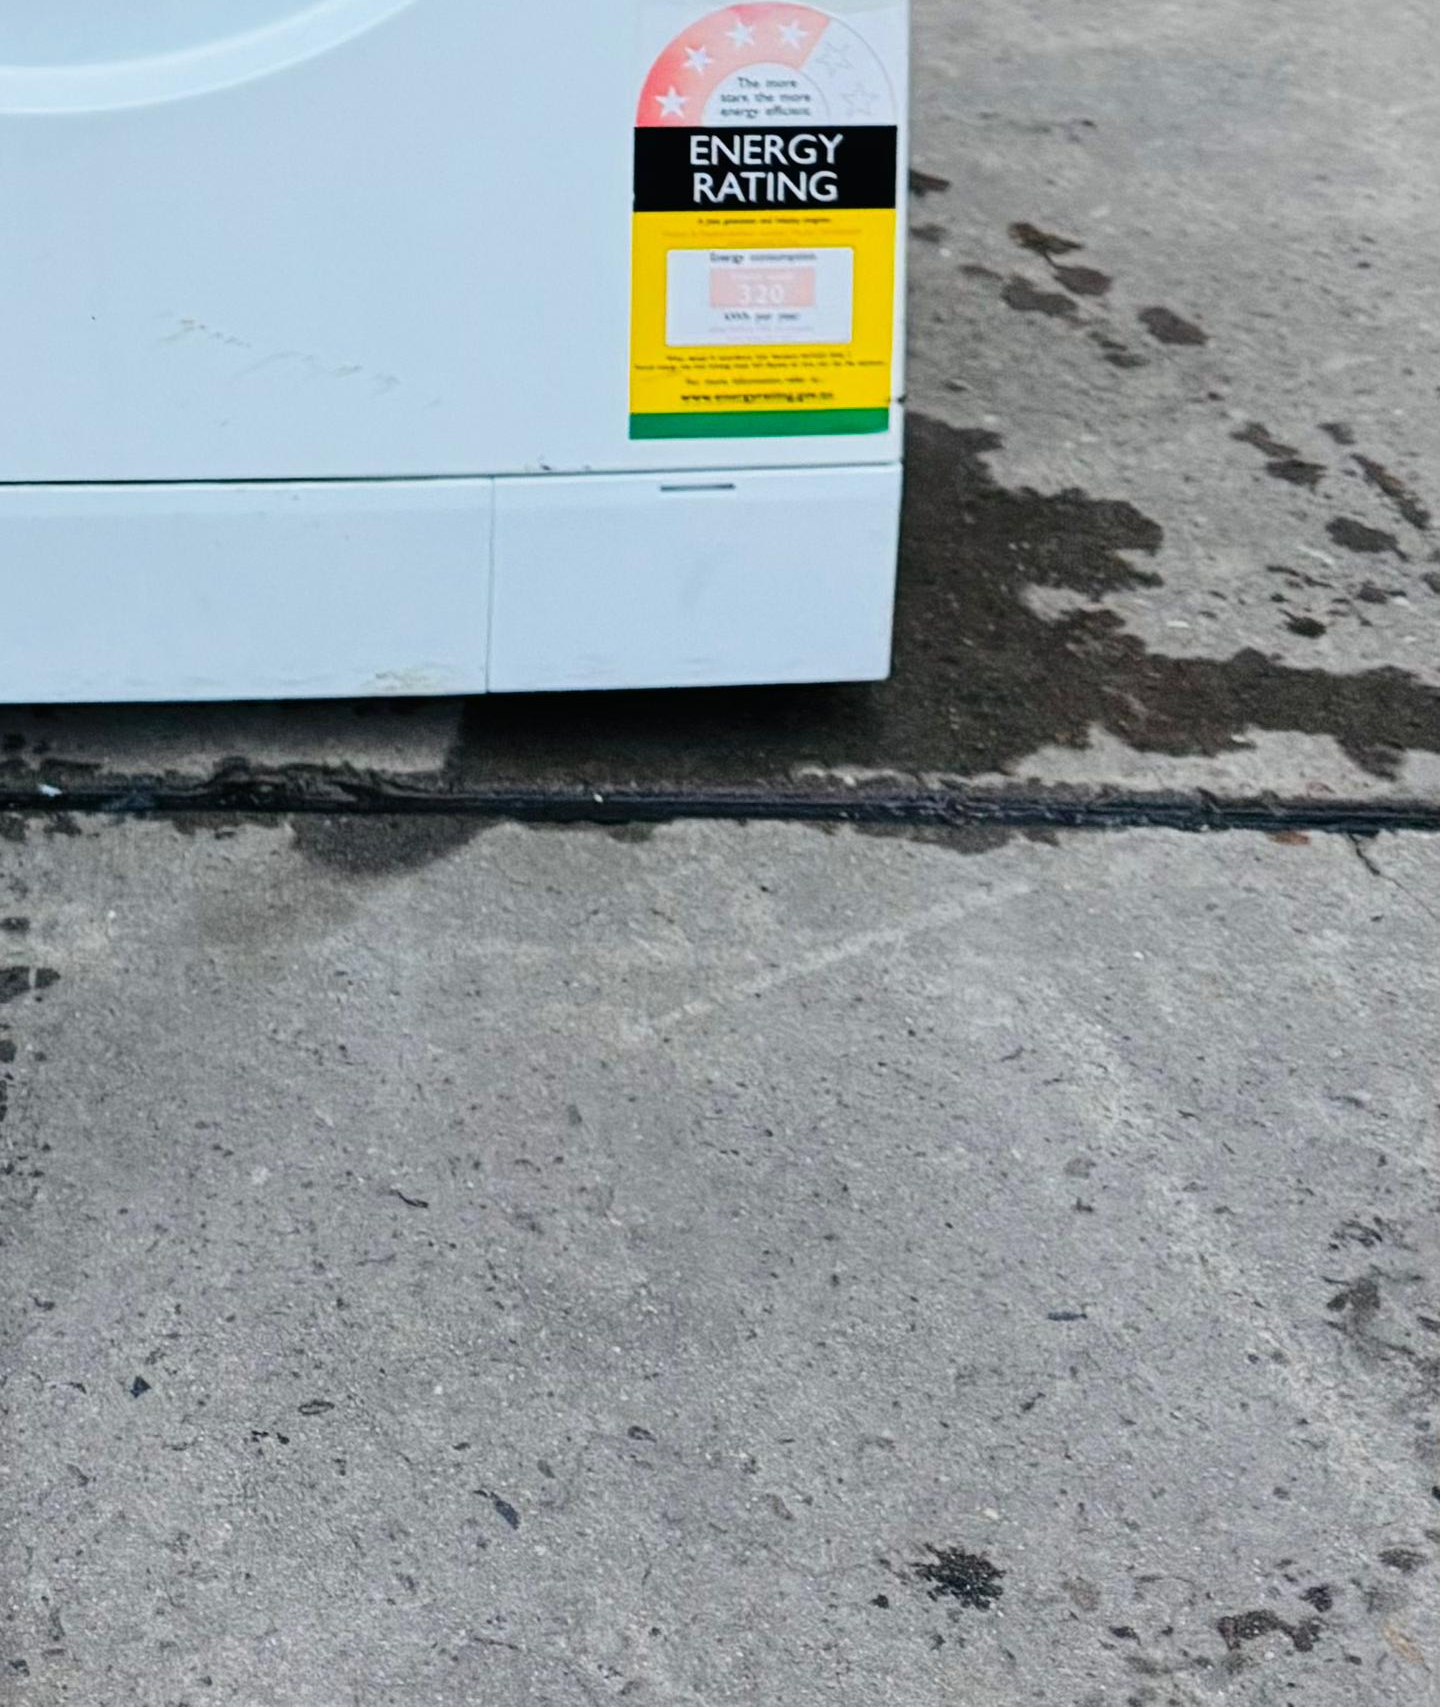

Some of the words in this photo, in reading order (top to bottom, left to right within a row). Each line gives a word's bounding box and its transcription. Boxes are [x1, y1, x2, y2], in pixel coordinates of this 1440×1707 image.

[738, 76, 759, 87] The
[690, 134, 844, 167] ENERGY
[693, 170, 838, 204] RATING
